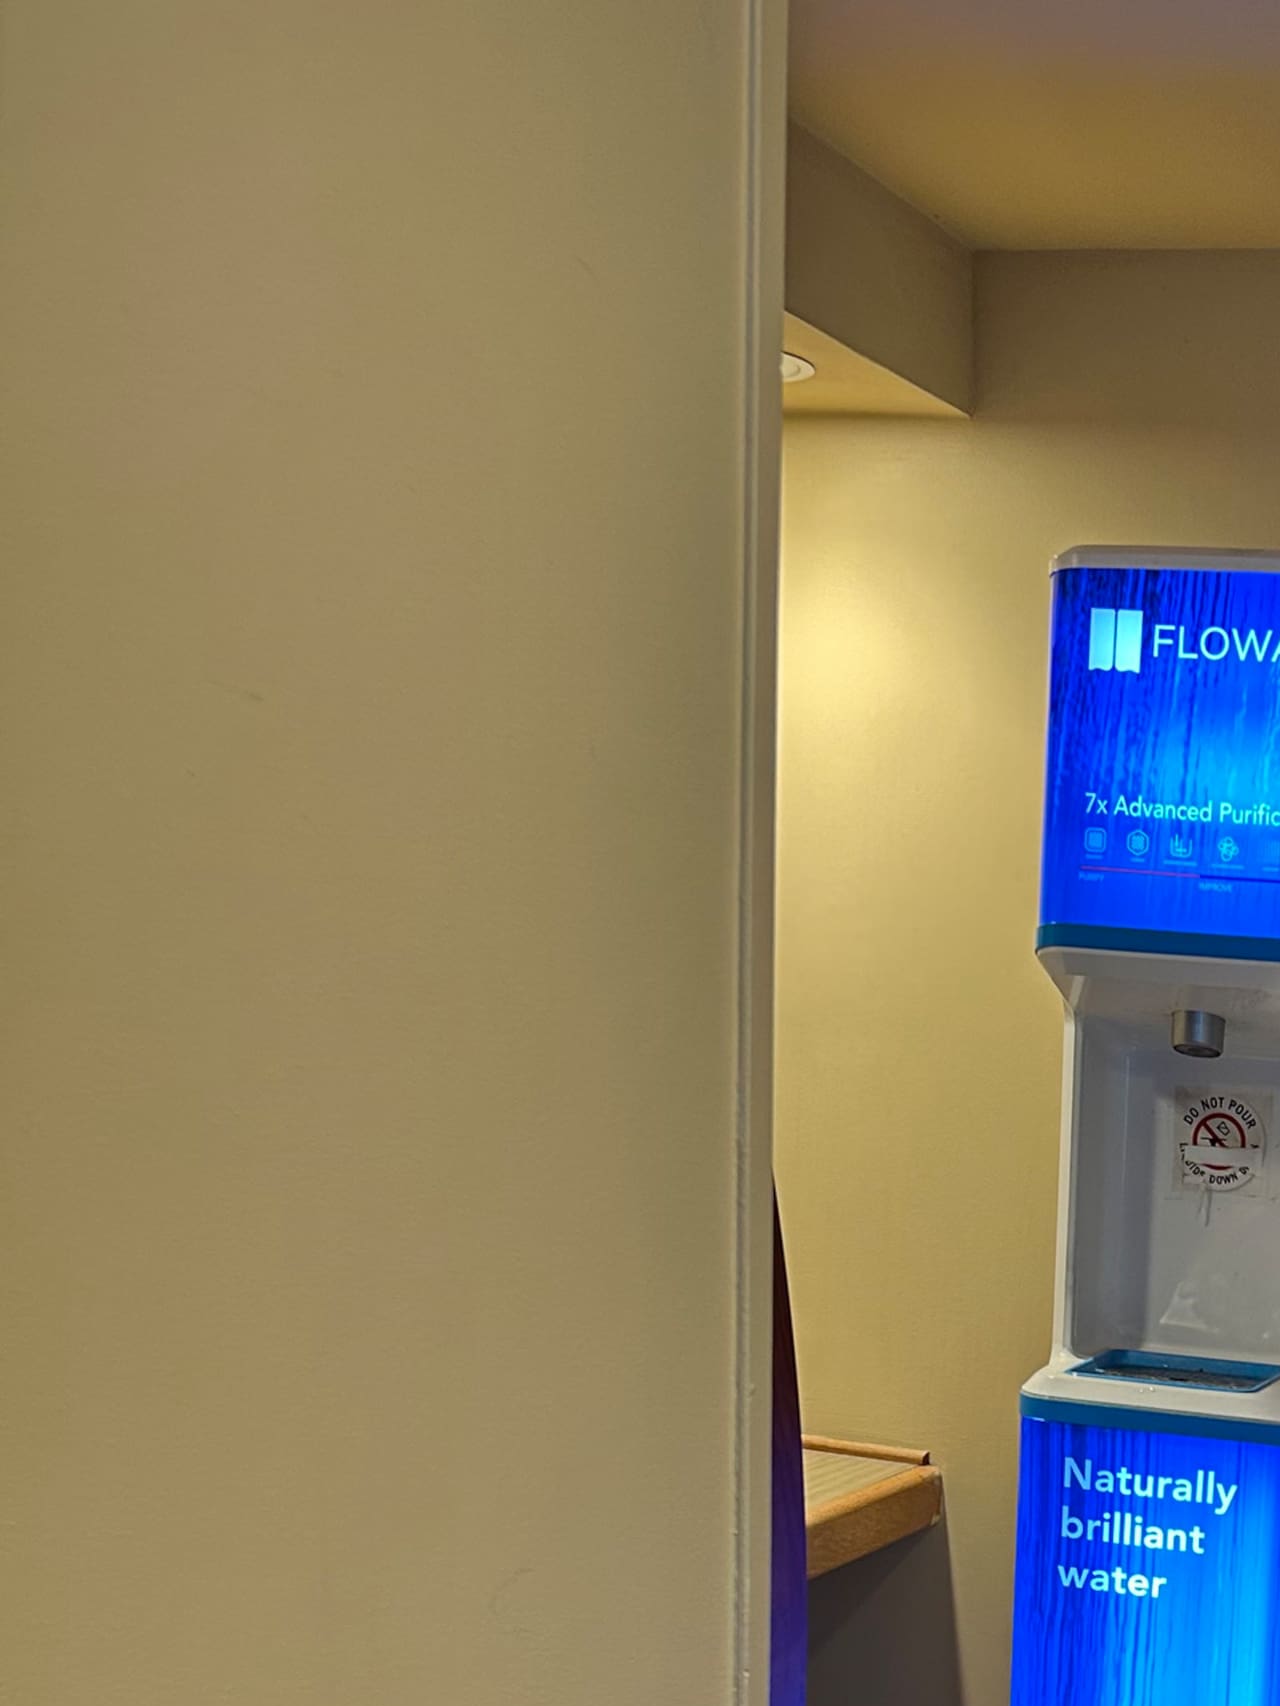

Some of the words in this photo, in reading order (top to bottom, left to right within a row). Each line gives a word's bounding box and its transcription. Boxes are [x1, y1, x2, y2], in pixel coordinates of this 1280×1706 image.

[1084, 791, 1108, 815] 7x
[1113, 794, 1213, 822] Advanced
[1183, 1107, 1199, 1126] DO
[1200, 1096, 1225, 1112] NOT
[1228, 1099, 1257, 1129] POUR
[1208, 1171, 1239, 1185] DOWN
[1063, 1456, 1238, 1516] Naturally
[1061, 1505, 1205, 1555] brilliant
[1057, 1564, 1167, 1599] water
